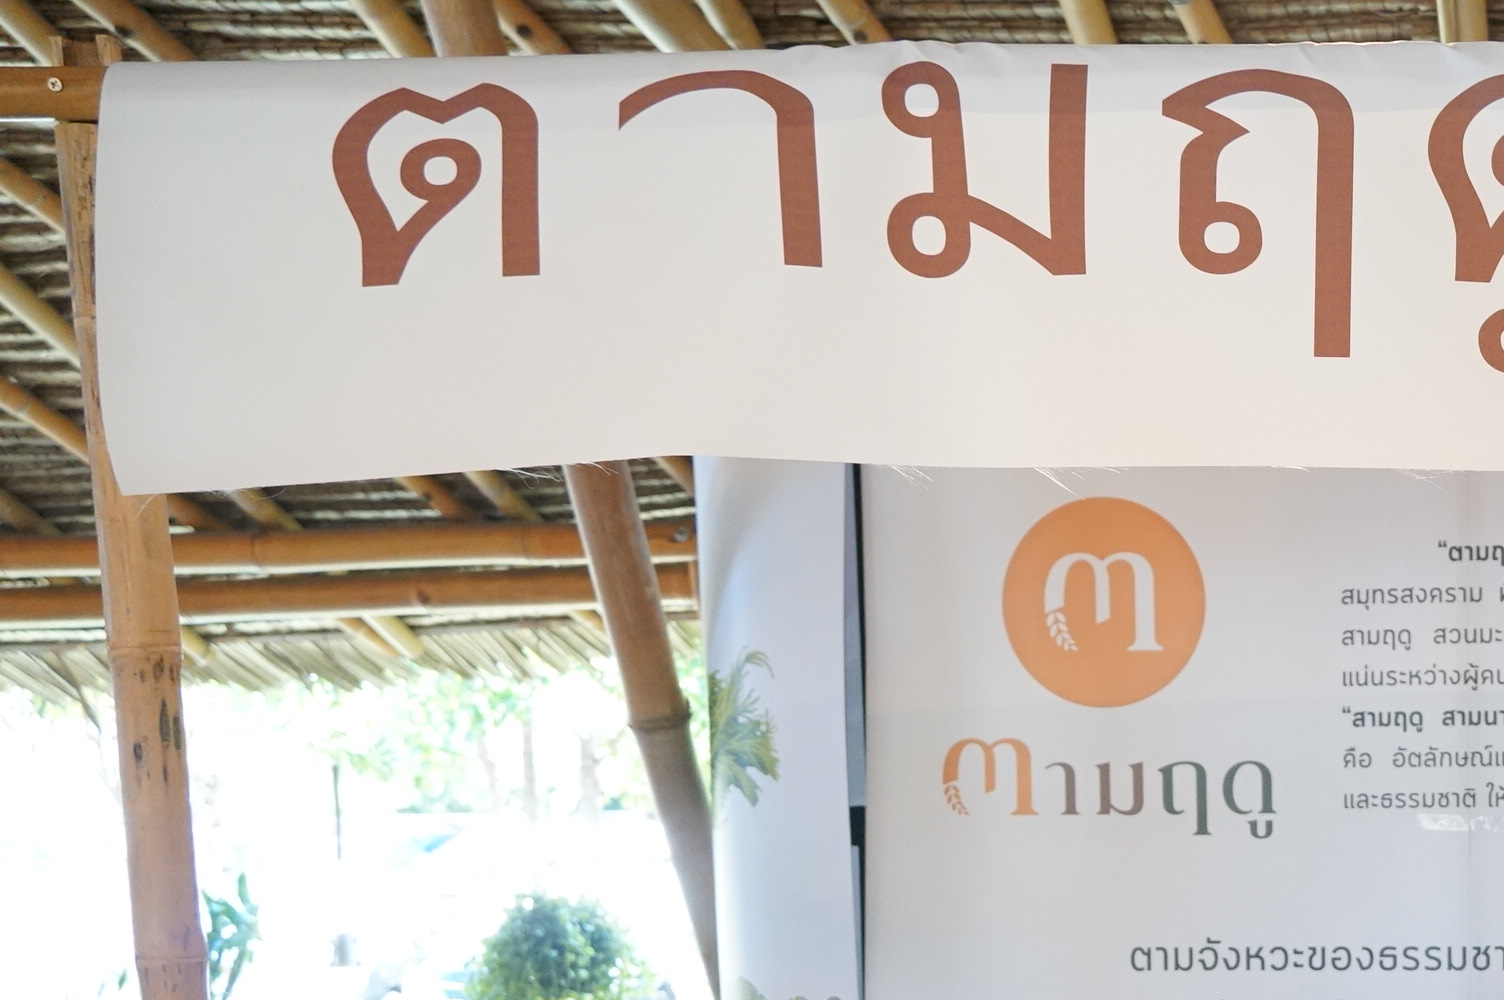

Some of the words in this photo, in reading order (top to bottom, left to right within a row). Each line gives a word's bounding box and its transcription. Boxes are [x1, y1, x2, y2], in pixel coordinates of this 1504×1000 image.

[1341, 586, 1483, 610] สมุทรสงคราม
[1341, 628, 1412, 651] สามฤดู
[1342, 706, 1423, 733] “สามฤดู
[1343, 747, 1372, 769] คือ
[942, 737, 1277, 839] ตามฤดู
[1343, 787, 1477, 810] และธรรมชาติ
